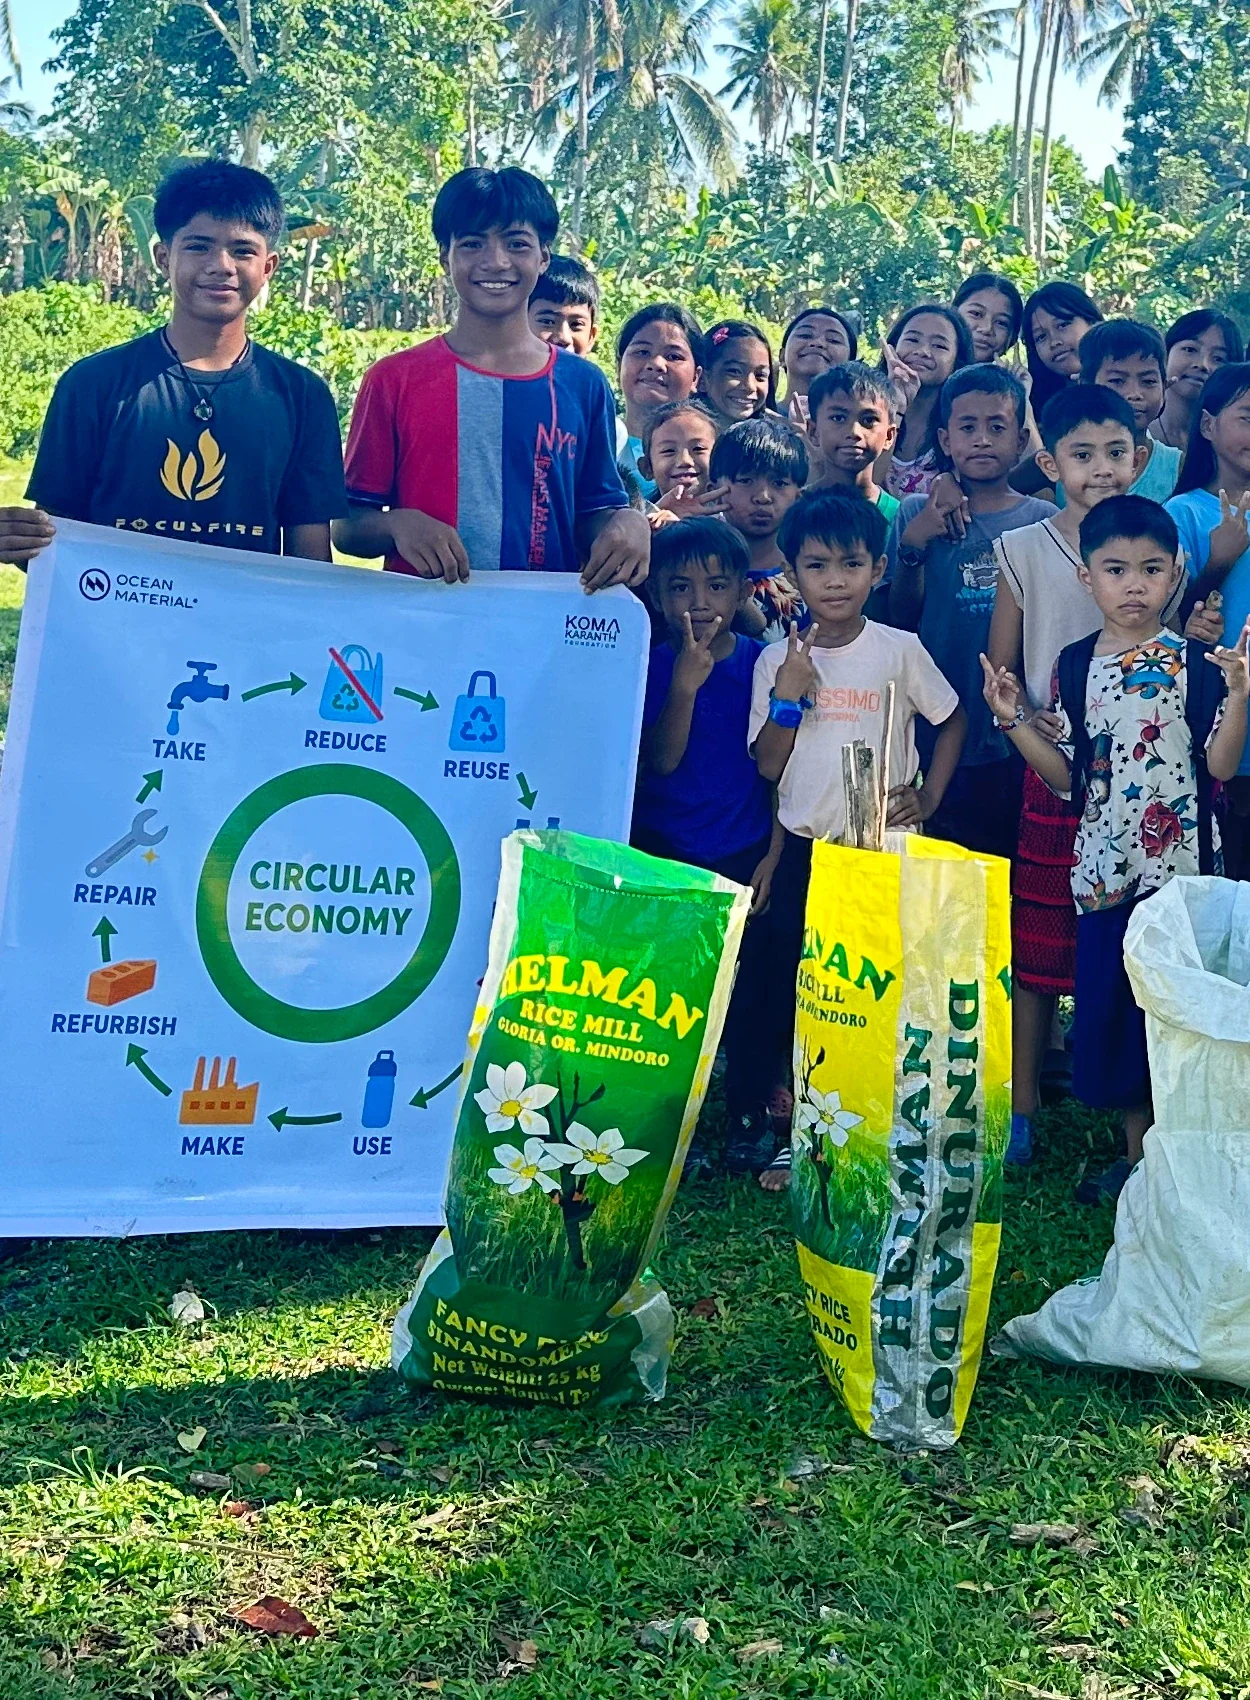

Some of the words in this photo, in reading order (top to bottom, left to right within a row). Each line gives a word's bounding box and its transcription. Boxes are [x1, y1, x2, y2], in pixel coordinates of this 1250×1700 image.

[116, 518, 264, 536] FOCUSFIRE
[116, 574, 173, 590] OCEAN
[564, 629, 617, 642] KARANTH
[565, 615, 621, 633] KOMA
[152, 739, 206, 762] TAKE
[304, 729, 387, 754] REDUCE
[444, 760, 510, 781] REUSE
[249, 861, 416, 896] CIRCULAR
[74, 883, 157, 906] REPAIR
[245, 902, 413, 936] ECONOMY
[51, 1013, 177, 1036] REFURBISH
[520, 998, 578, 1031] RICE
[582, 1014, 643, 1043] MILL
[498, 1016, 546, 1046] GLORIA
[551, 1034, 581, 1053] OR.
[585, 1041, 670, 1067] MINDORO
[181, 1136, 245, 1157] MAKE
[353, 1136, 392, 1157] USE
[879, 1022, 933, 1351] HELMAN
[925, 978, 980, 1420] DINURADO
[820, 1292, 851, 1325] RICE
[436, 1297, 528, 1349] FANCY
[432, 1351, 467, 1374] Net
[548, 1371, 571, 1387] 25
